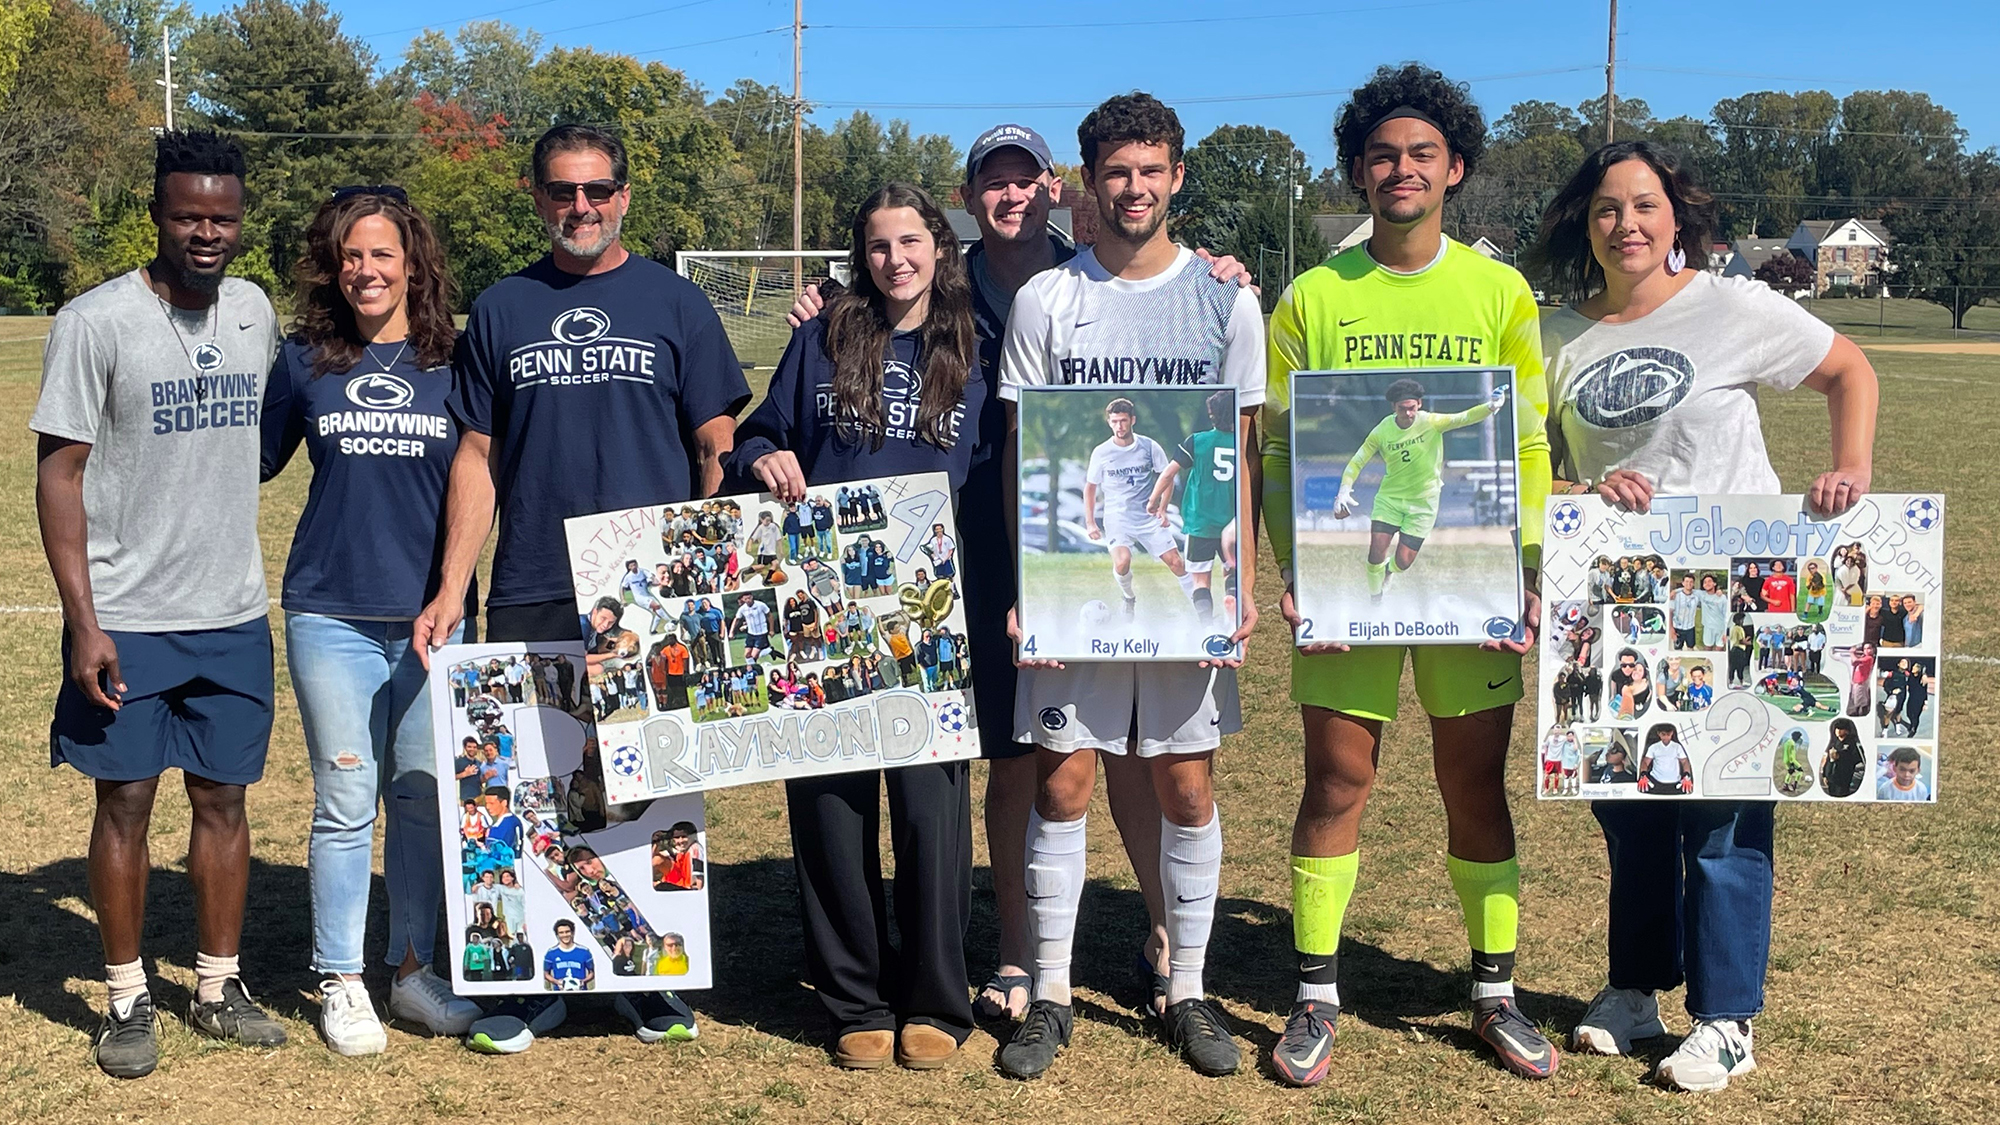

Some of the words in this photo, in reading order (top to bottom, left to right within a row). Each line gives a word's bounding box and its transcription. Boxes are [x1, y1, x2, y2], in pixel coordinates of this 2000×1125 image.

[1004, 127, 1033, 140] STATE
[1344, 333, 1404, 363] PENN
[1409, 333, 1482, 364] STATE
[510, 348, 572, 382] PENN
[582, 345, 655, 376] STATE
[1059, 357, 1211, 385] BRANDYWINE
[151, 373, 258, 407] BRANDYWINE
[550, 372, 610, 385] SOCCER
[153, 400, 258, 436] SOCCER
[318, 411, 448, 439] BRANDYWINE
[339, 436, 425, 457] SOCCER
[1401, 450, 1411, 462] 2
[1212, 447, 1235, 481] 5
[1126, 475, 1135, 486] 4
[1650, 496, 1842, 556] Jebooty
[575, 507, 656, 597] CAPTAIN
[1541, 502, 1637, 600] ELIJAH
[1300, 618, 1314, 639] 2
[1349, 621, 1390, 640] Elijah
[1394, 620, 1459, 637] DeBooth
[1024, 634, 1038, 656] 4
[1091, 638, 1119, 657] Ray
[1123, 638, 1160, 657] Kelly
[643, 693, 930, 789] RAYMOND
[1726, 724, 1778, 774] CAPTAIN
